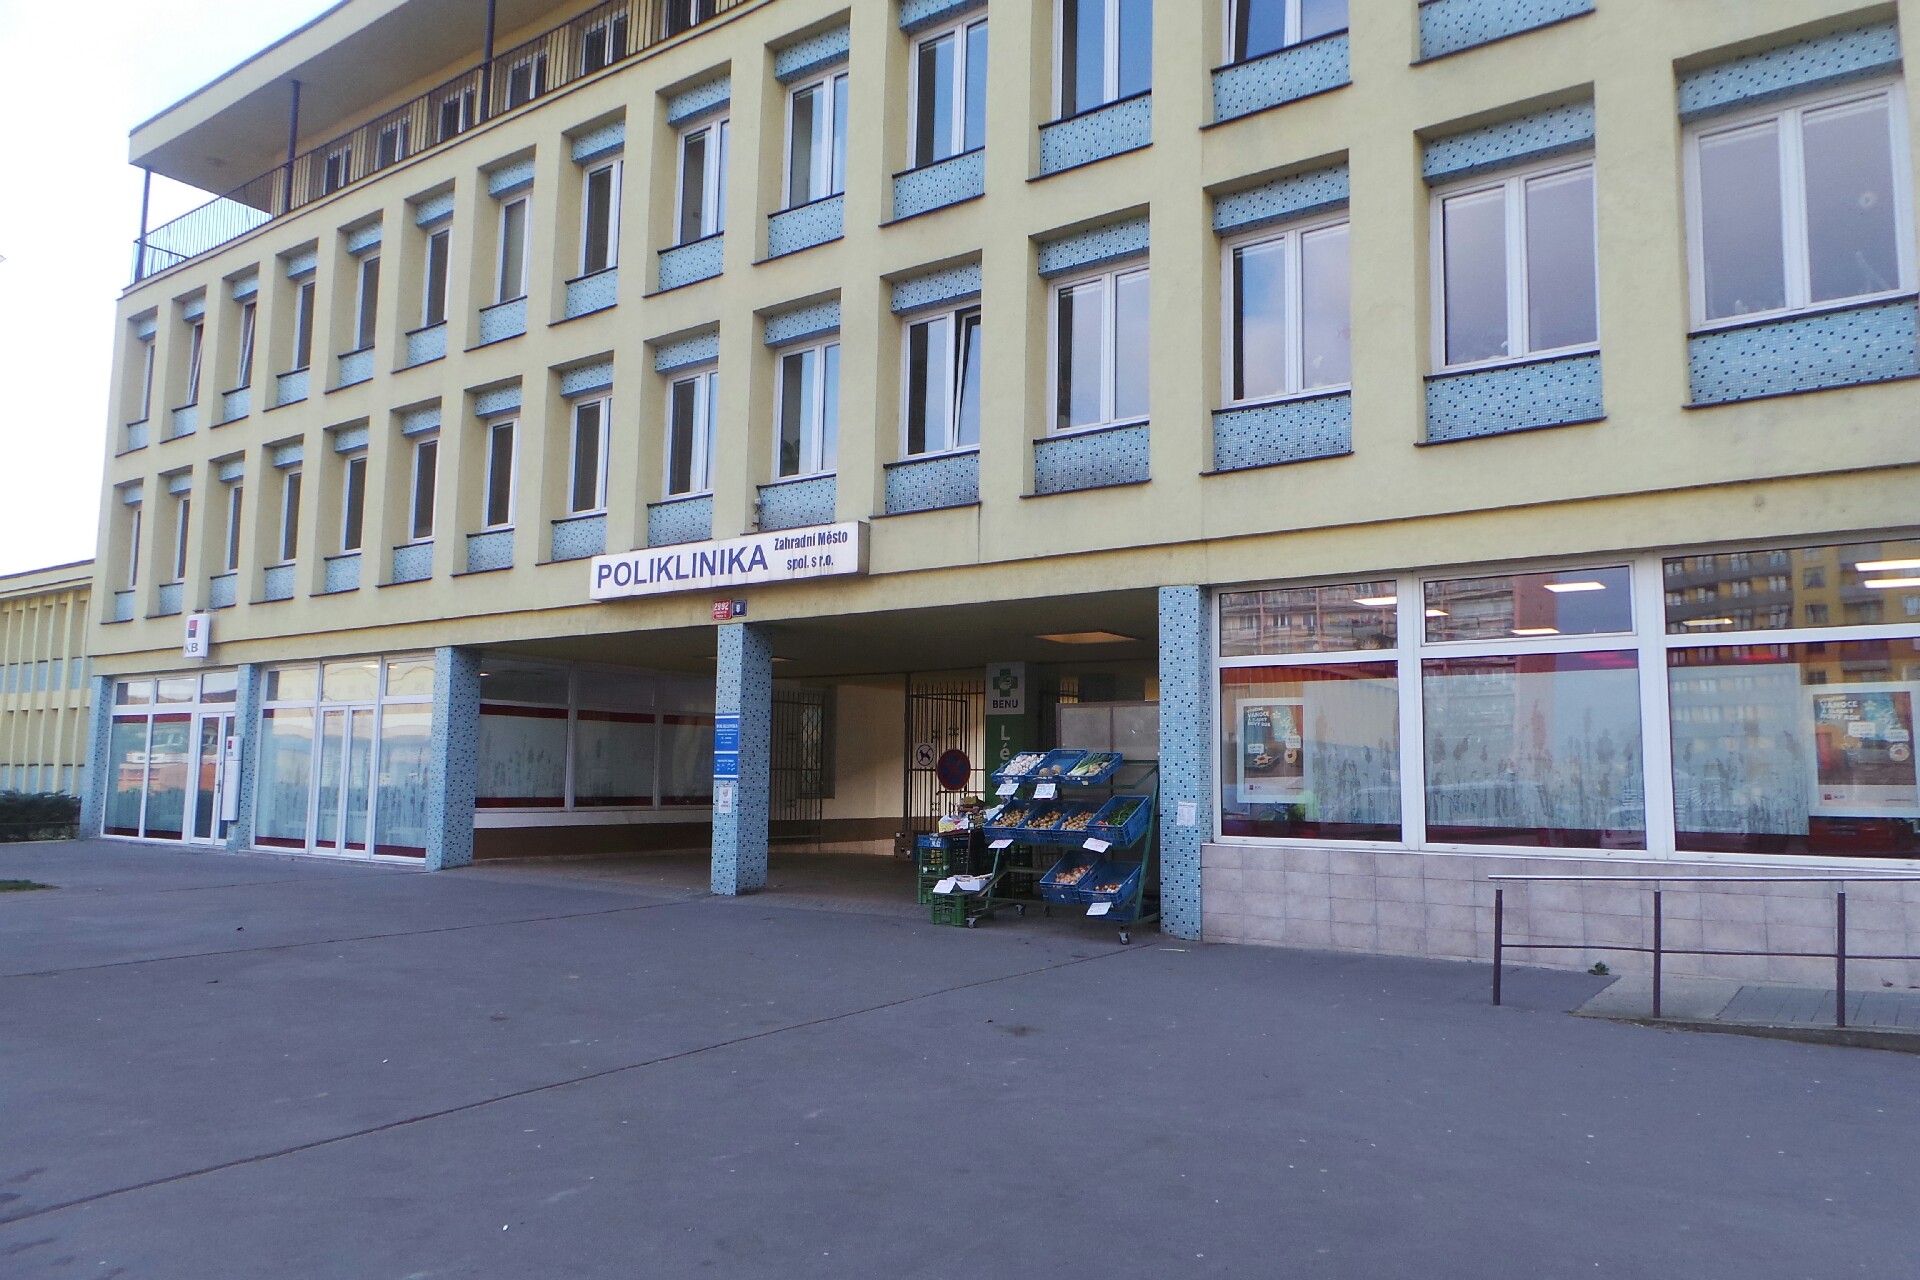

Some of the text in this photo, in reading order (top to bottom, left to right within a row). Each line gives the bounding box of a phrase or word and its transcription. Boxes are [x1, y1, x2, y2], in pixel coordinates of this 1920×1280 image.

[774, 531, 848, 551] Zahradní Město
[597, 544, 769, 589] POLIKLINIKA
[786, 554, 834, 571] spol. s r.o.
[184, 642, 199, 653] KB
[992, 699, 1019, 709] BENU
